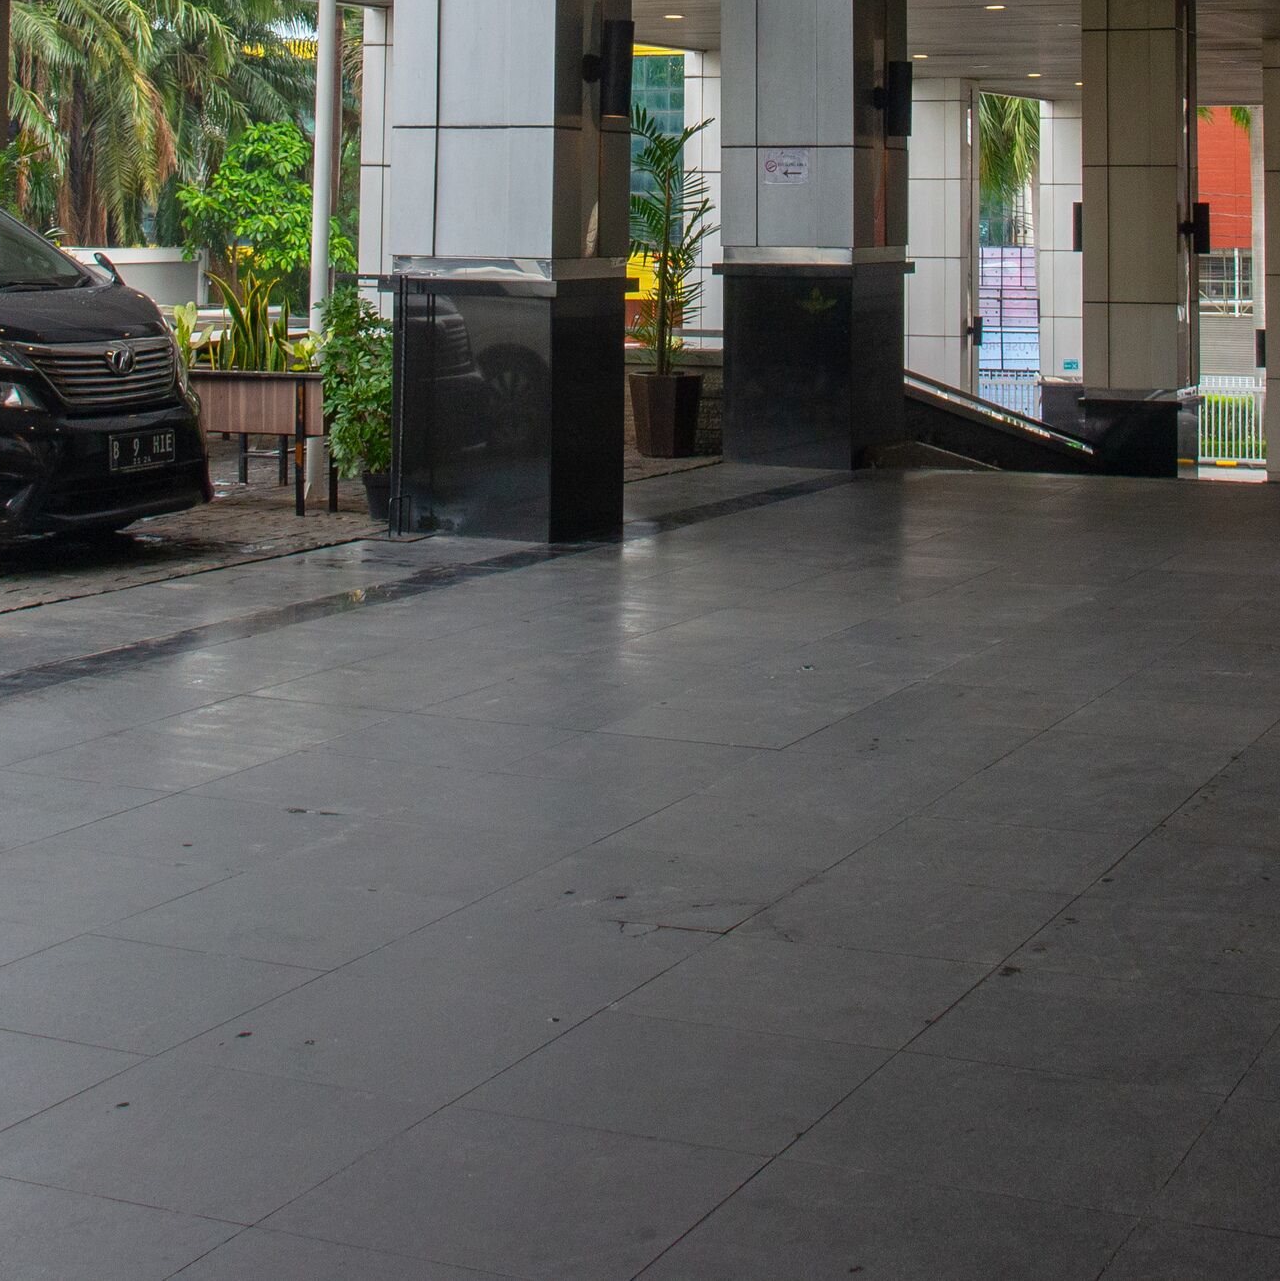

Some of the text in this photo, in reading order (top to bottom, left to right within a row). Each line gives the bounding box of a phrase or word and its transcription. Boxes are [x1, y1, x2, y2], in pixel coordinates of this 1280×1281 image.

[113, 434, 173, 460] B 9 HIE
